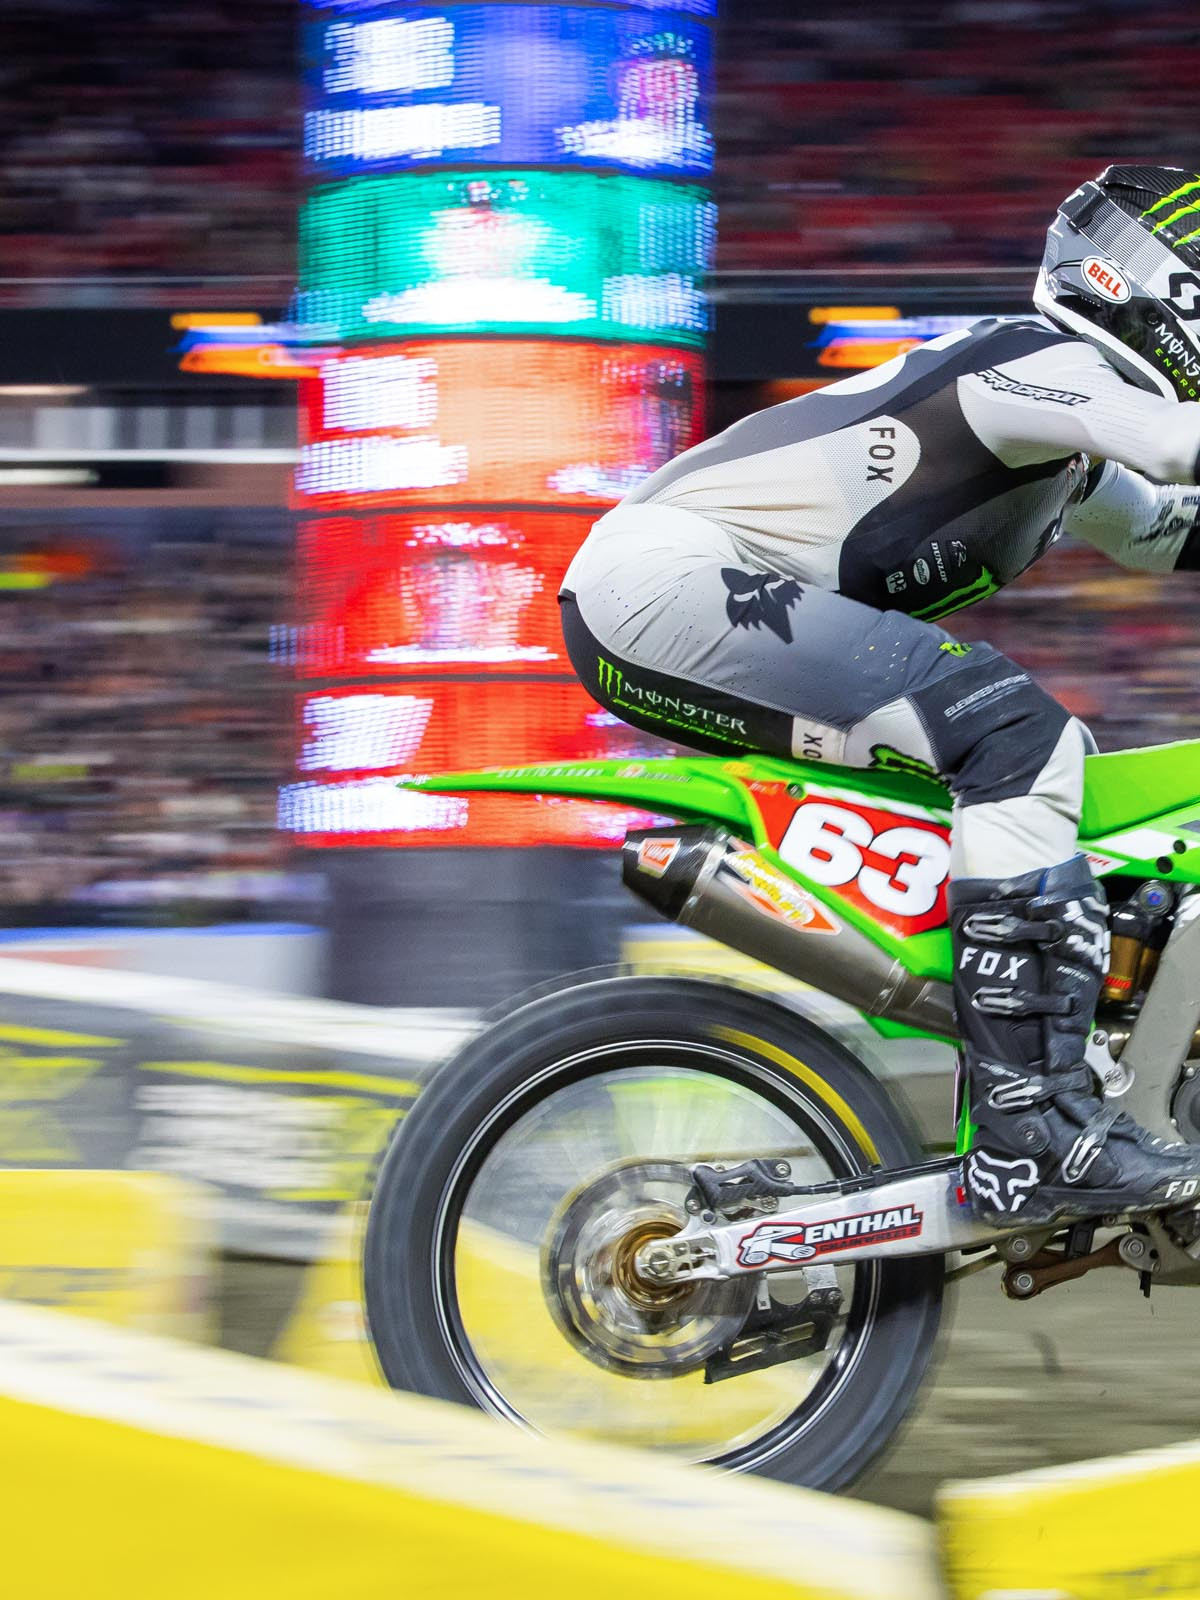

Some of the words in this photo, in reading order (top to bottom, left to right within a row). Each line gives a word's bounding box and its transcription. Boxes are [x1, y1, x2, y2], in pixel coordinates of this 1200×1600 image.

[1087, 262, 1122, 298] BELL
[867, 427, 896, 483] FOX
[930, 541, 948, 583] DUNLOP
[624, 681, 748, 735] MONSTER
[803, 732, 824, 760] OX
[777, 801, 952, 918] 63
[959, 946, 1029, 981] FOX
[740, 1207, 921, 1265] RENTHAL
